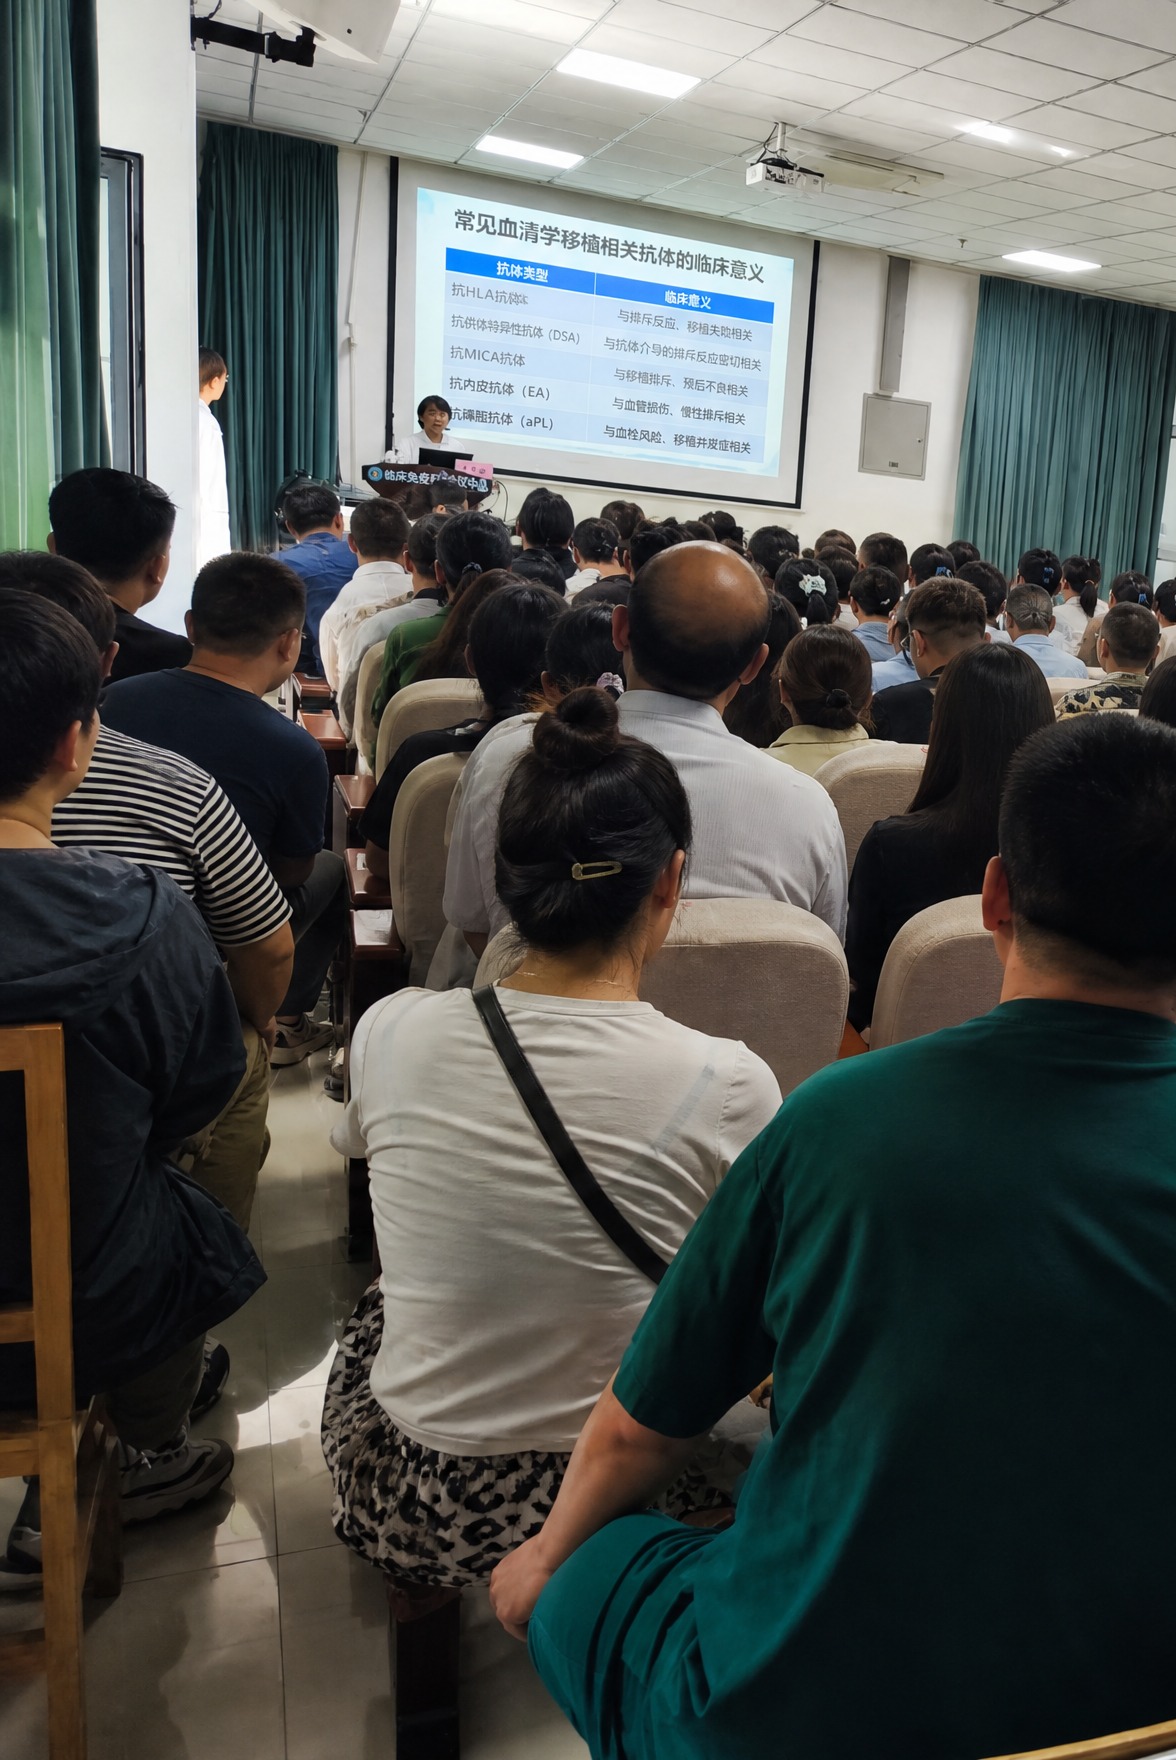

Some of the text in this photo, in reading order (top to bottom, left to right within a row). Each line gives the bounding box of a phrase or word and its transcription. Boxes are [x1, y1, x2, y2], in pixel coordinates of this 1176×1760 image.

[454, 208, 764, 283] 常见血清学移植相关抗体的临床意义
[496, 261, 549, 283] 抗体类型
[450, 345, 526, 367] 抗MICA抗体
[449, 375, 551, 401] 抗内皮抗体（EA）
